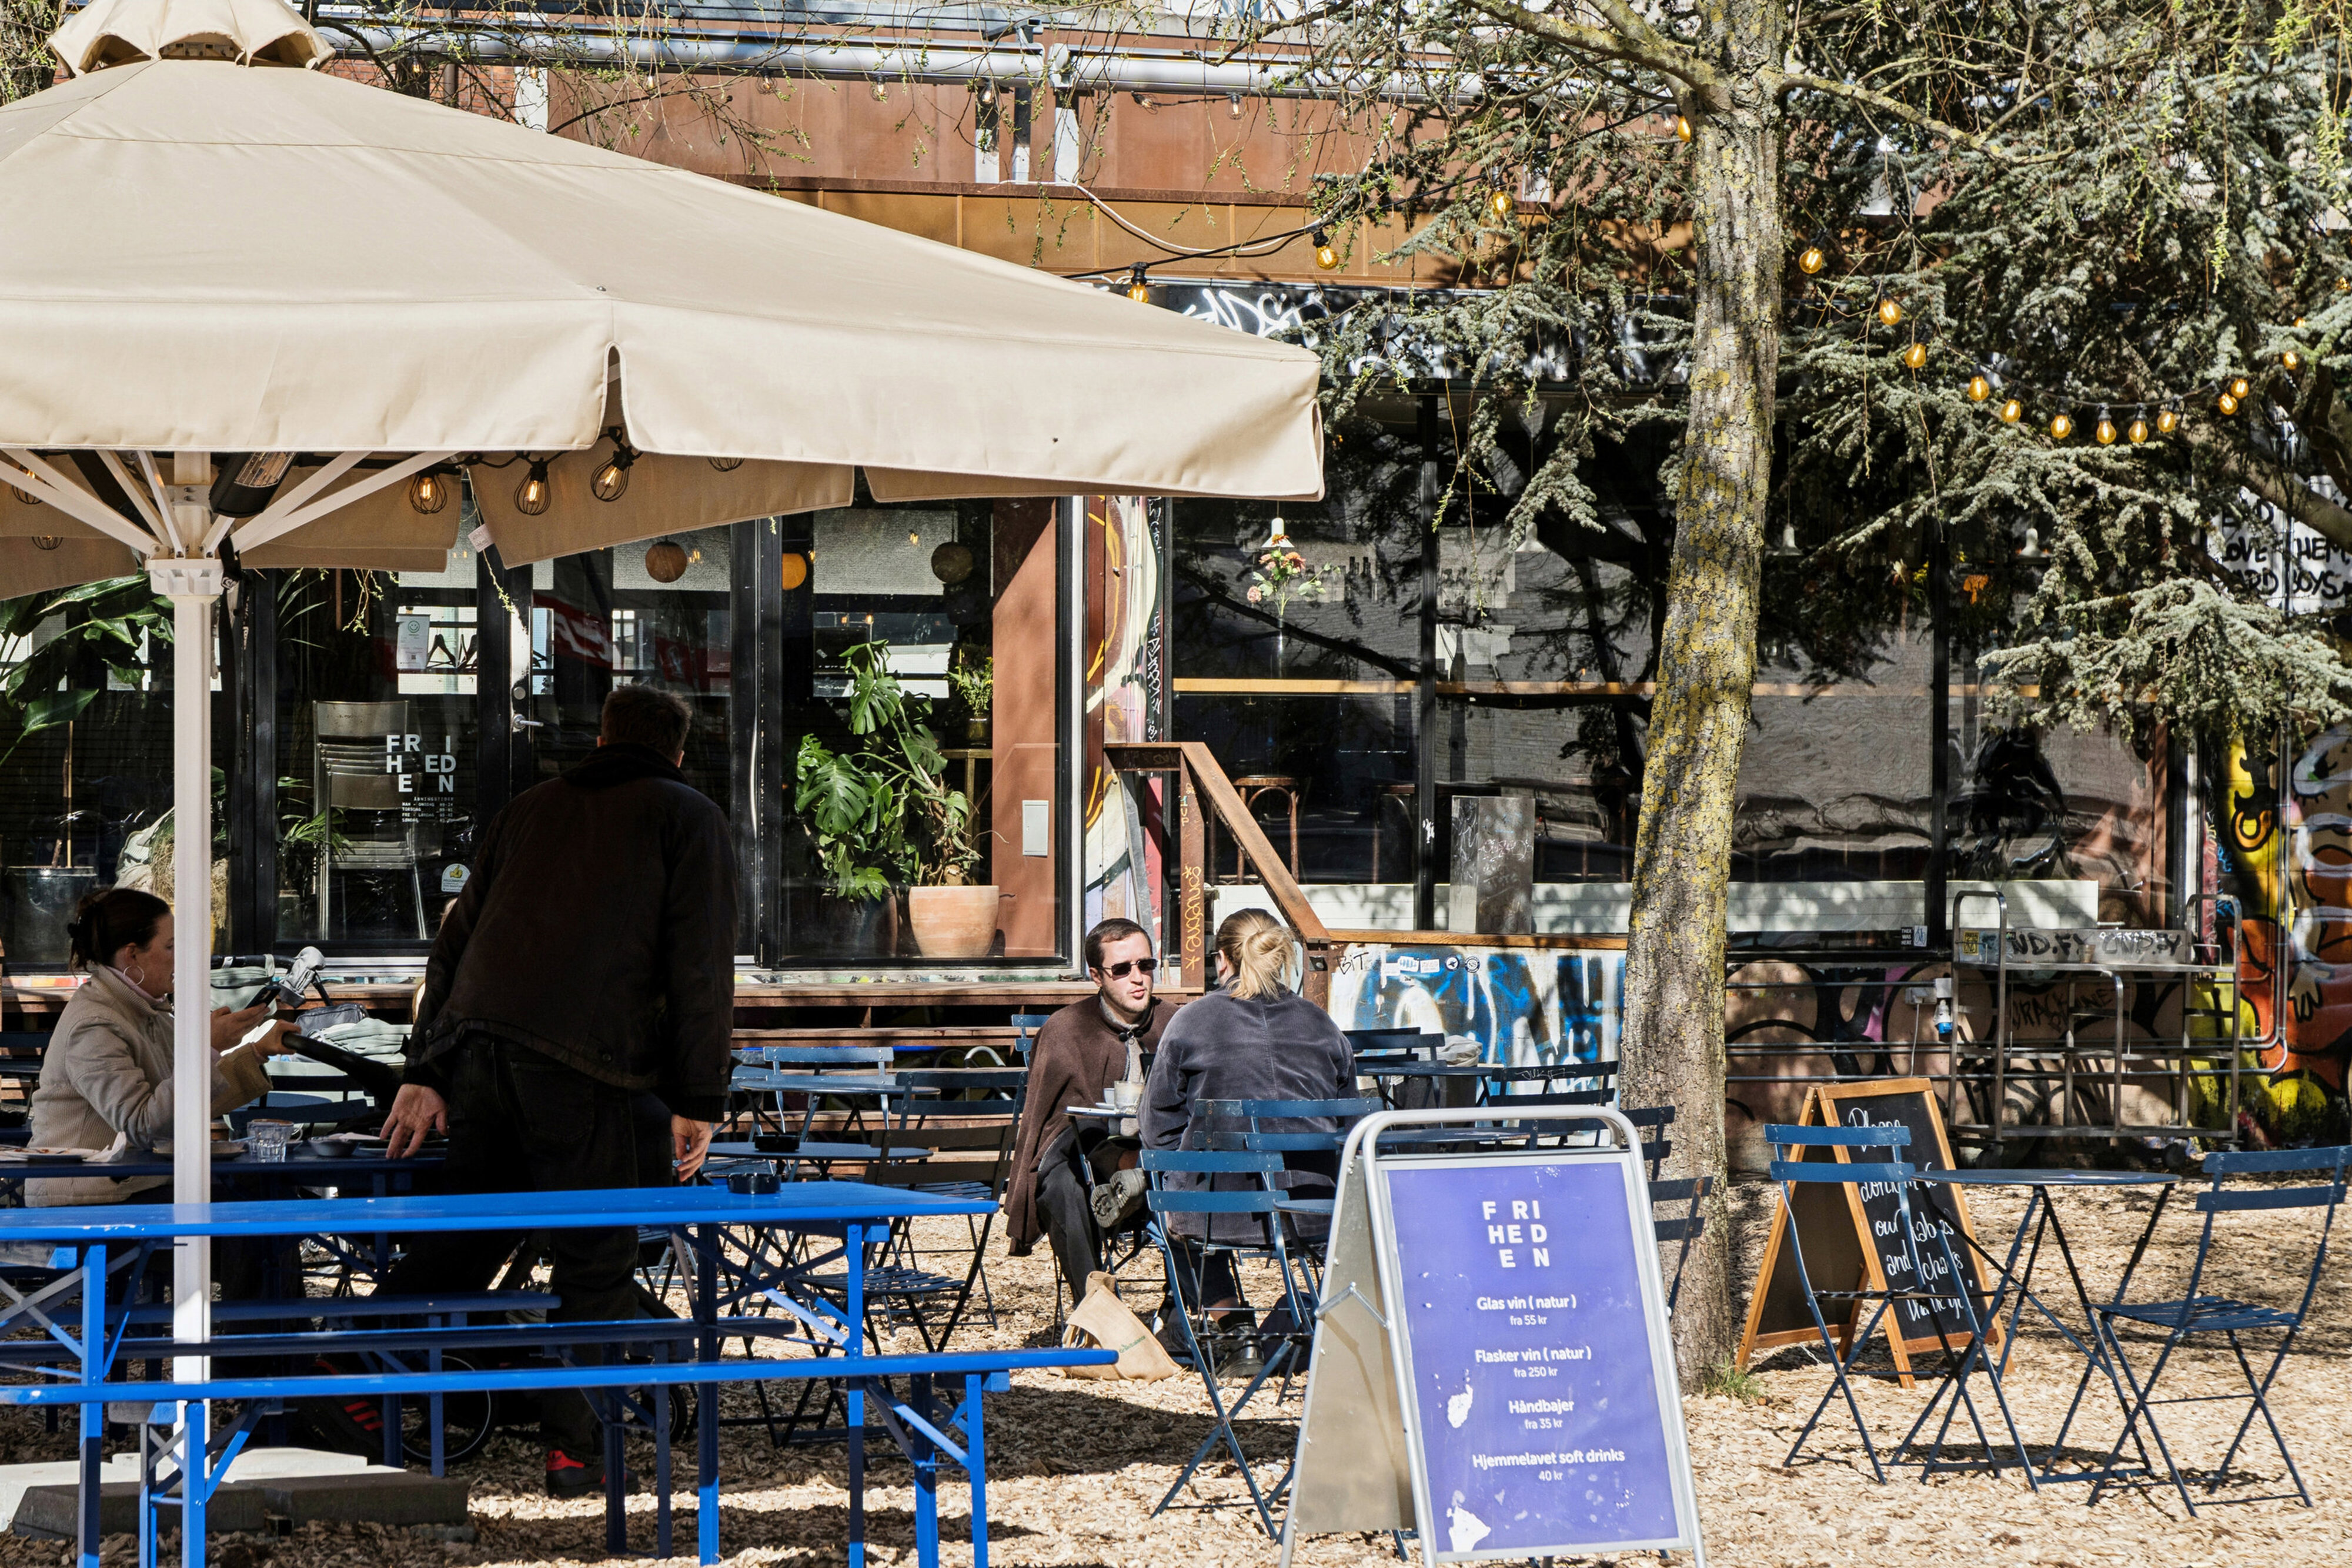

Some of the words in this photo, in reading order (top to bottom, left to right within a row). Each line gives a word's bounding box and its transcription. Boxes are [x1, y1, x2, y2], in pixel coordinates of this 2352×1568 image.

[1476, 1297, 1505, 1310] Glas
[1507, 1296, 1526, 1309] vin
[1510, 1316, 1523, 1326] fra
[1524, 1315, 1537, 1325] 55
[1538, 1315, 1548, 1325] kr
[1475, 1349, 1519, 1363] Flasker
[1521, 1348, 1541, 1362] vin
[1514, 1368, 1527, 1378] fra
[1528, 1367, 1547, 1378] 250
[1548, 1367, 1558, 1376] kr
[1508, 1399, 1575, 1415] Håndbajer
[1524, 1419, 1538, 1430] fra
[1539, 1418, 1552, 1429] 35
[1553, 1418, 1563, 1429] kr
[1472, 1452, 1558, 1470] Hjemmelavet
[1558, 1449, 1585, 1464] soft
[1586, 1448, 1626, 1463] drinks
[1538, 1470, 1552, 1482] 40
[1553, 1470, 1563, 1480] kr
